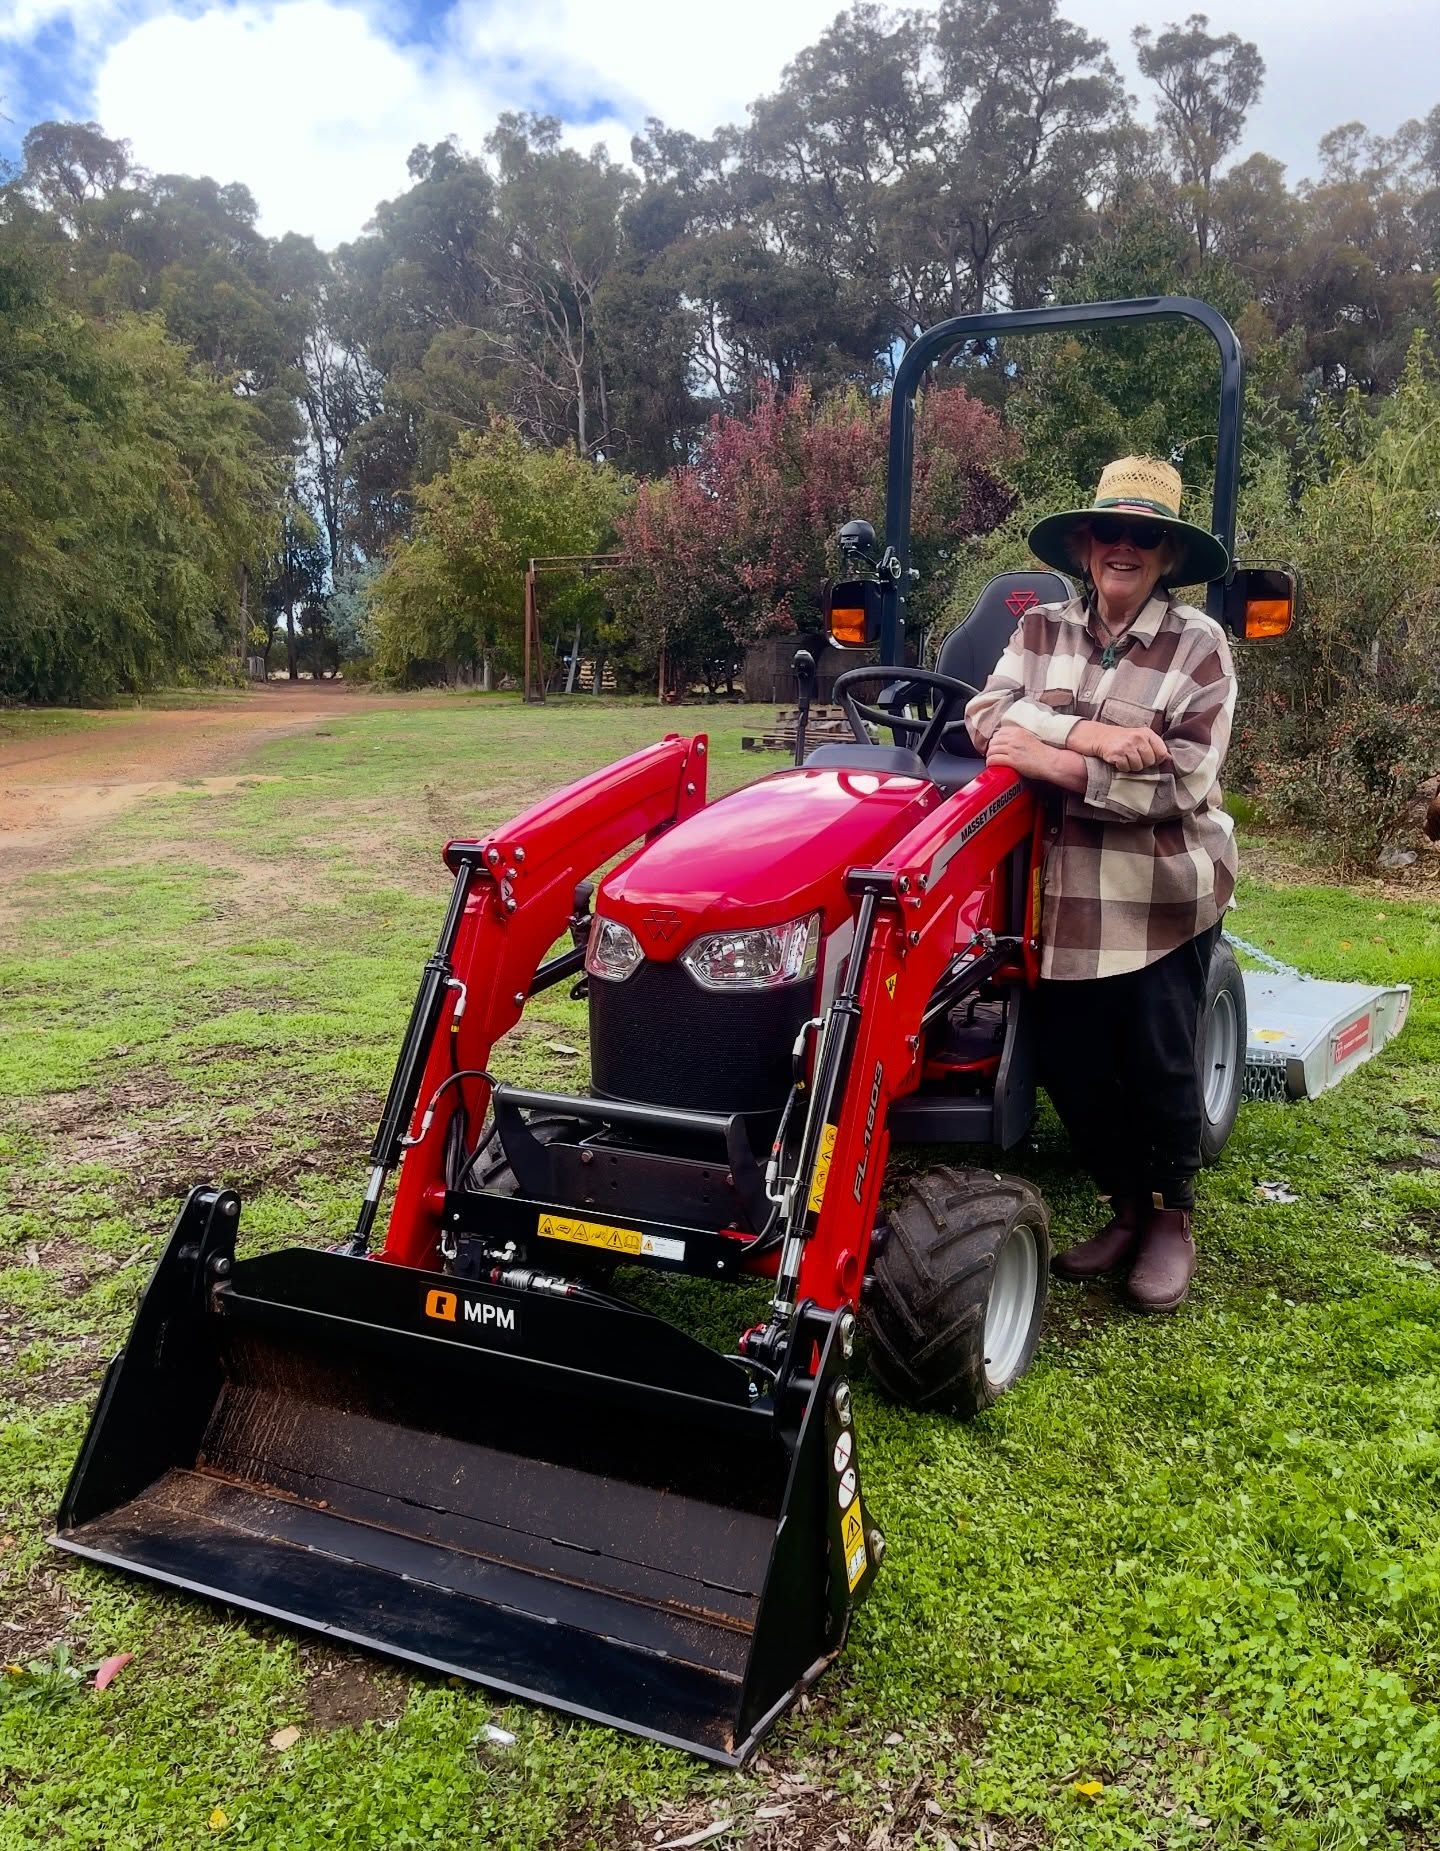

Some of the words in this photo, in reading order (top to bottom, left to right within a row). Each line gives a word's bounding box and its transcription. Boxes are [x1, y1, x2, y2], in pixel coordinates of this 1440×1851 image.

[960, 810, 988, 842] MASSEY
[989, 782, 1022, 816] FERGUSON
[464, 1300, 515, 1330] MPM
